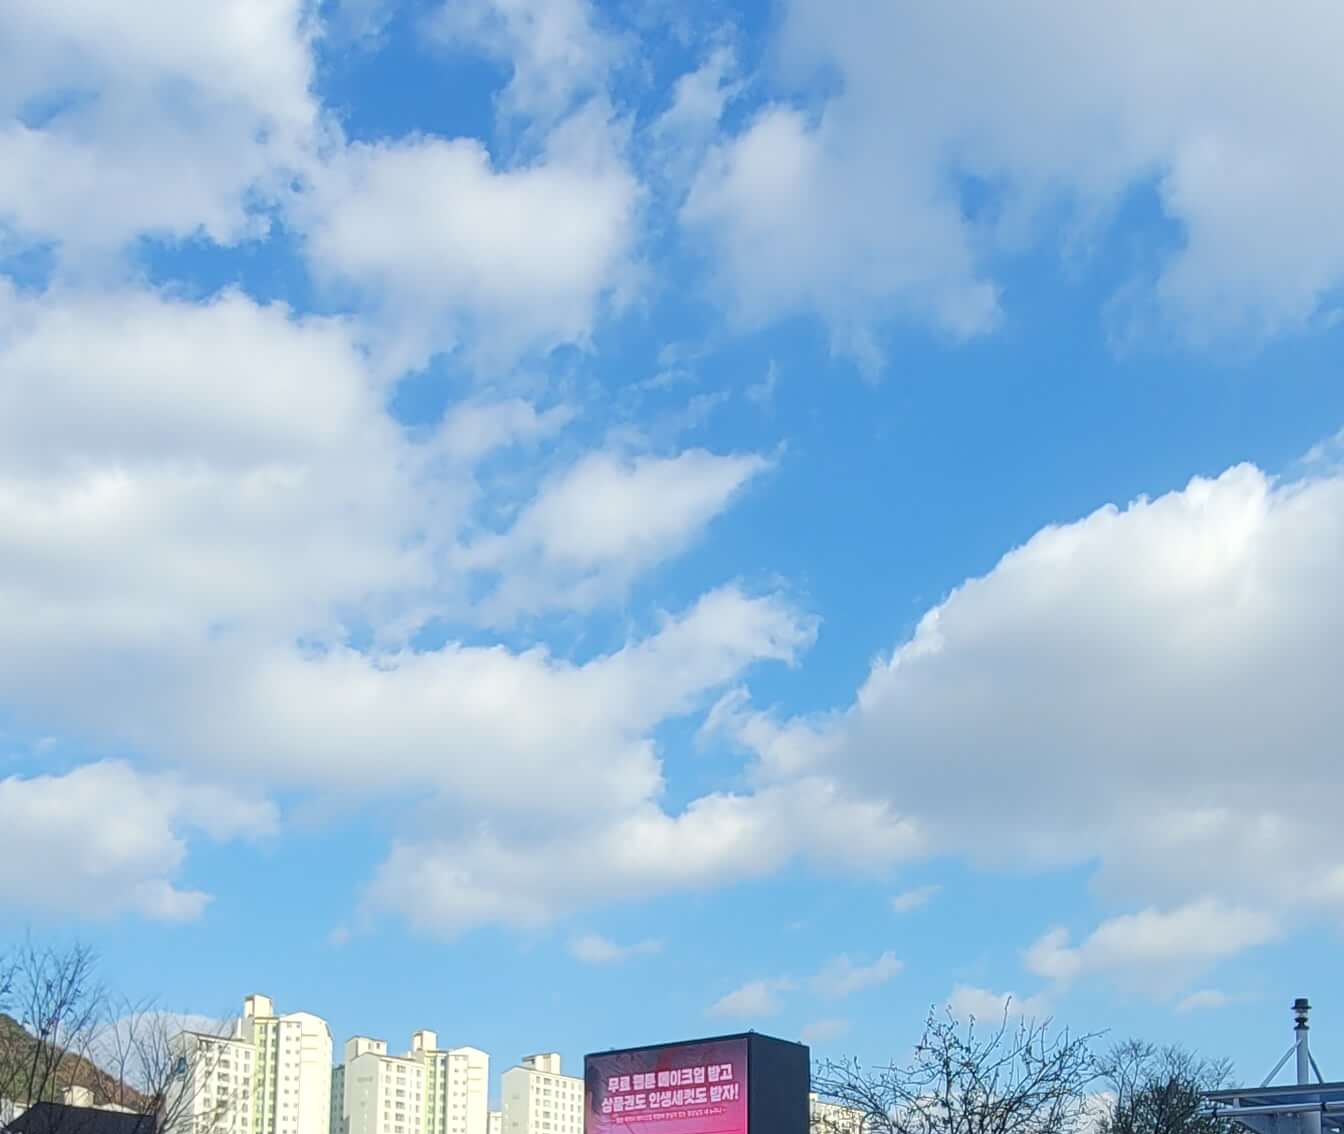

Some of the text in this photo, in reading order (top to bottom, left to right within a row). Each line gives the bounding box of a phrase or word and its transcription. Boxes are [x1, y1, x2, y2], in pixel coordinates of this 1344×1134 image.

[658, 1066, 705, 1087] 메이크업
[708, 1063, 733, 1082] 받고
[601, 1094, 647, 1113] 상품권도
[710, 1083, 739, 1102] 받자!
